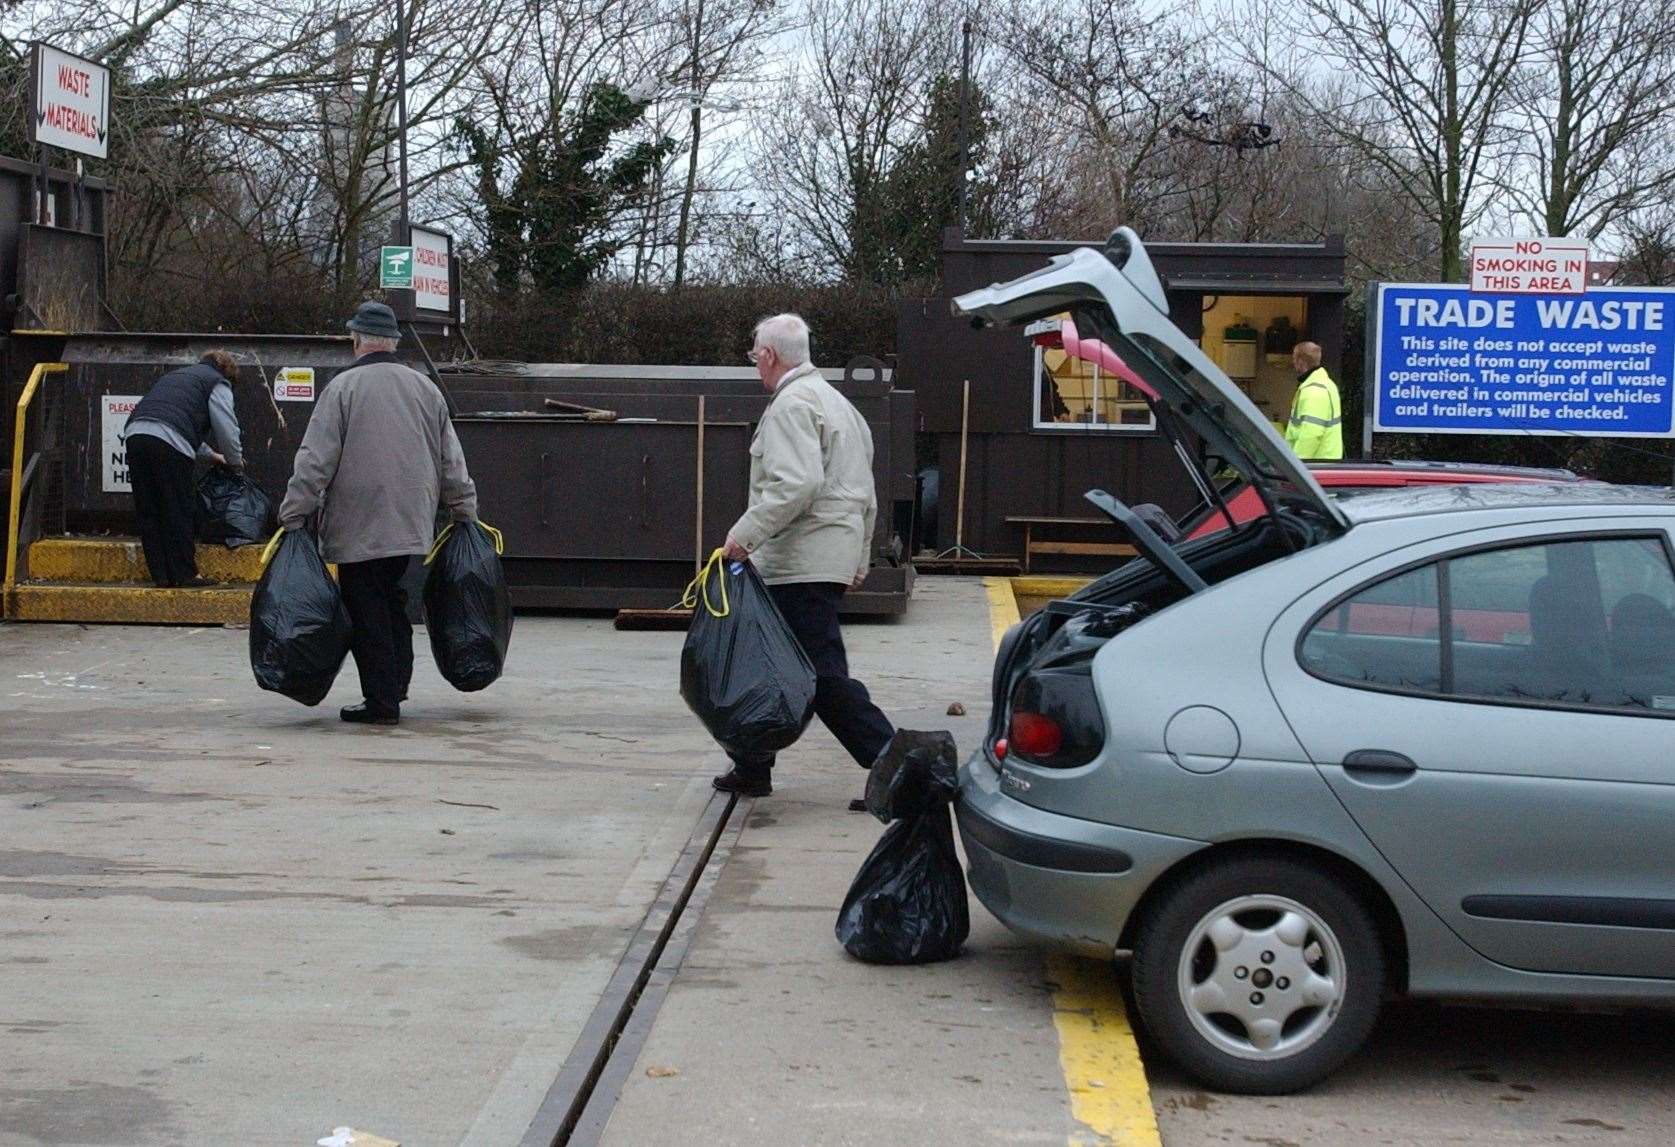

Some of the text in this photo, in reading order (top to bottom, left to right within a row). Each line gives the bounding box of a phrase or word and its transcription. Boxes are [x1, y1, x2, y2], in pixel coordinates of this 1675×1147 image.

[58, 64, 90, 98] WASTE
[47, 102, 96, 139] MATERIALS
[1517, 242, 1542, 254] NO
[1476, 259, 1581, 272] SMOKING IN
[1483, 276, 1572, 290] THIS AREA
[1395, 298, 1664, 331] TRADE WASTE
[1401, 337, 1656, 356] This site does not accept waste
[1406, 354, 1650, 372] derived from any commercial
[1389, 370, 1666, 387] operation. The origin of all waste
[1390, 386, 1661, 404] delivered in commercial vehicles
[1396, 403, 1628, 420] and trailers will be checked.
